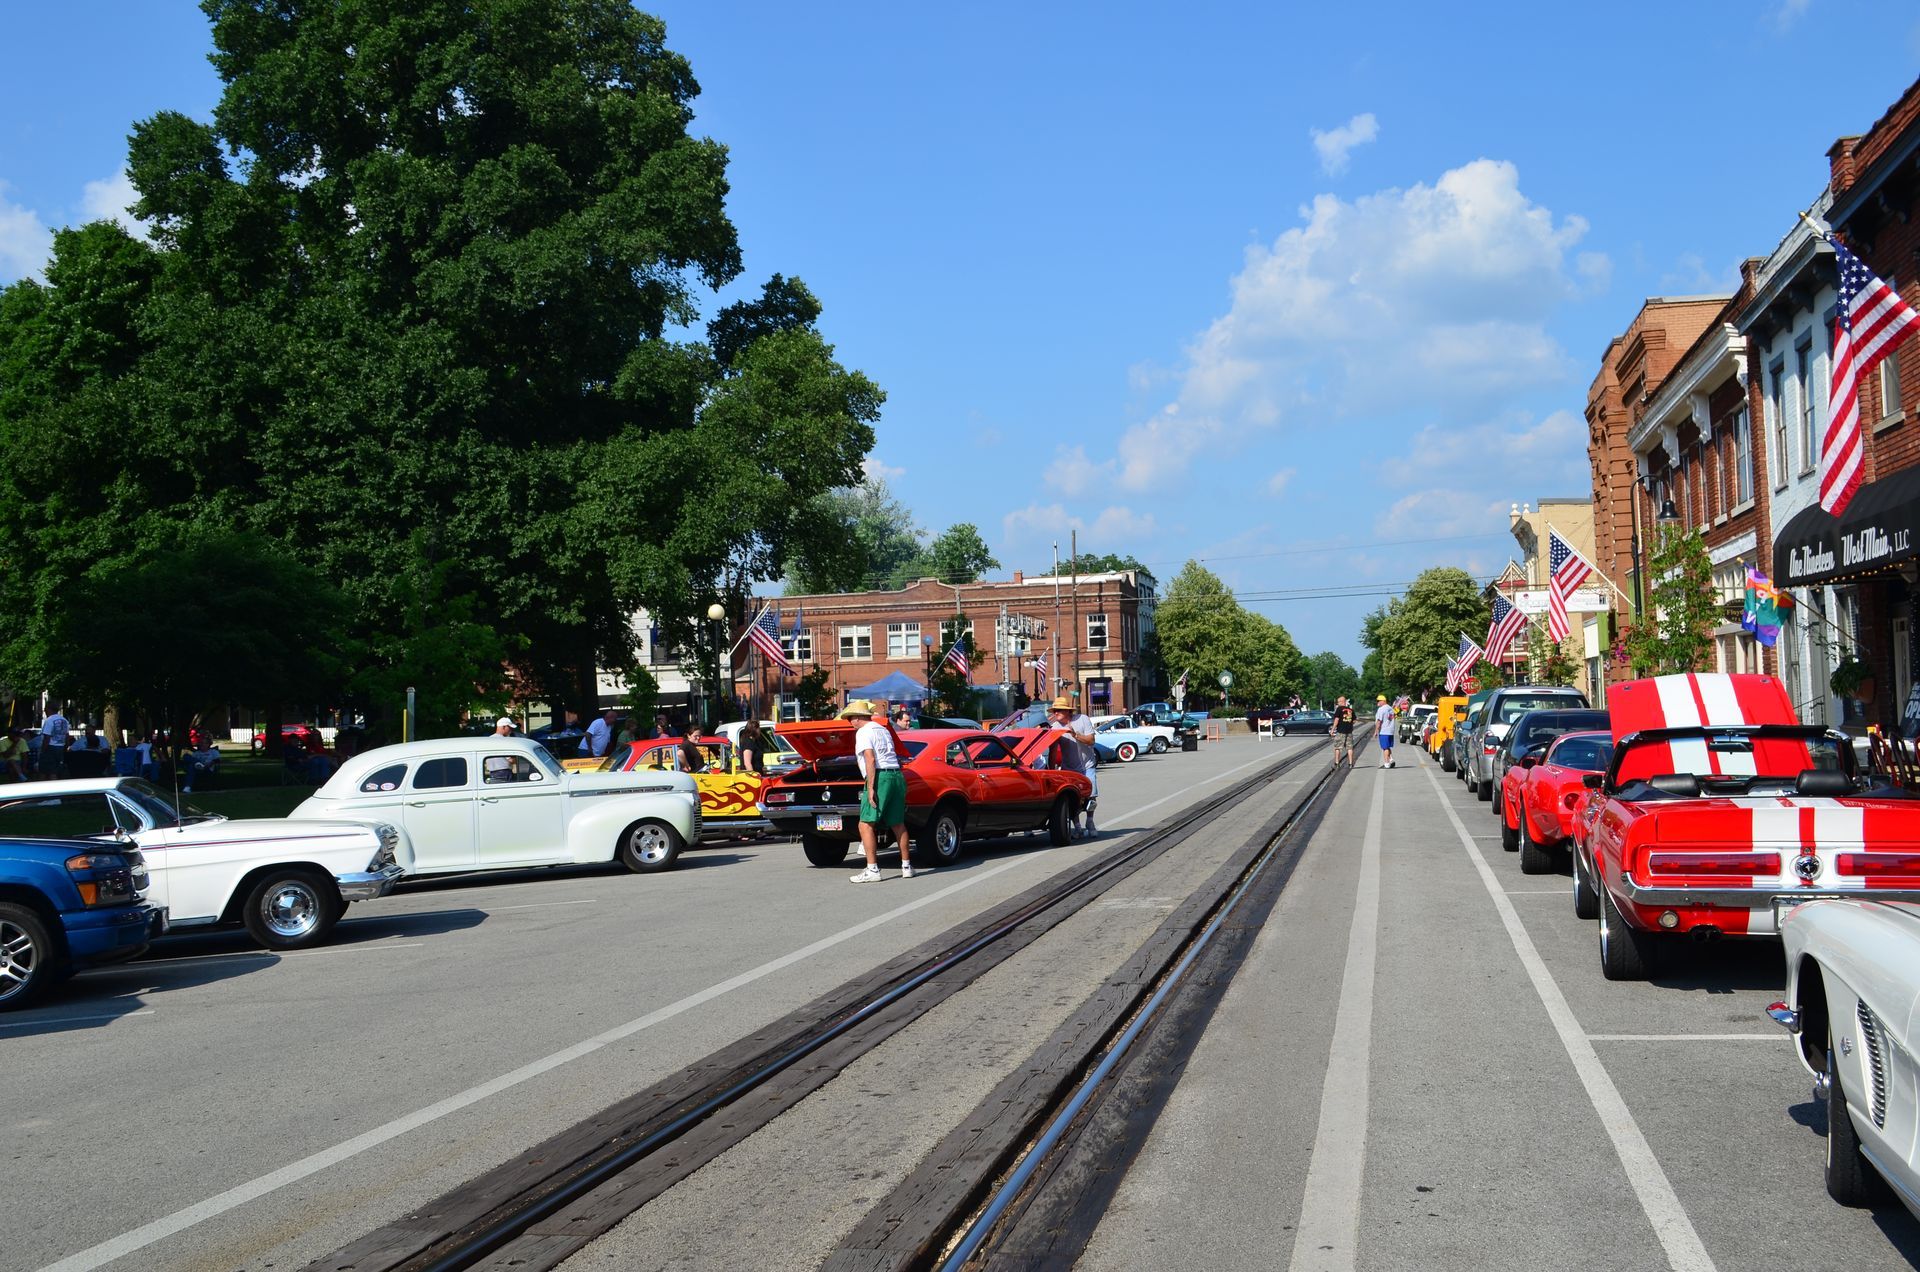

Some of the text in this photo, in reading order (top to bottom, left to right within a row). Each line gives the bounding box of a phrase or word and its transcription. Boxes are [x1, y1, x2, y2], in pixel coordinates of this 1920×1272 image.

[1789, 548, 1803, 578] One
[1802, 541, 1835, 576] Nineteen
[1841, 532, 1865, 566] West
[1894, 528, 1910, 552] LLC
